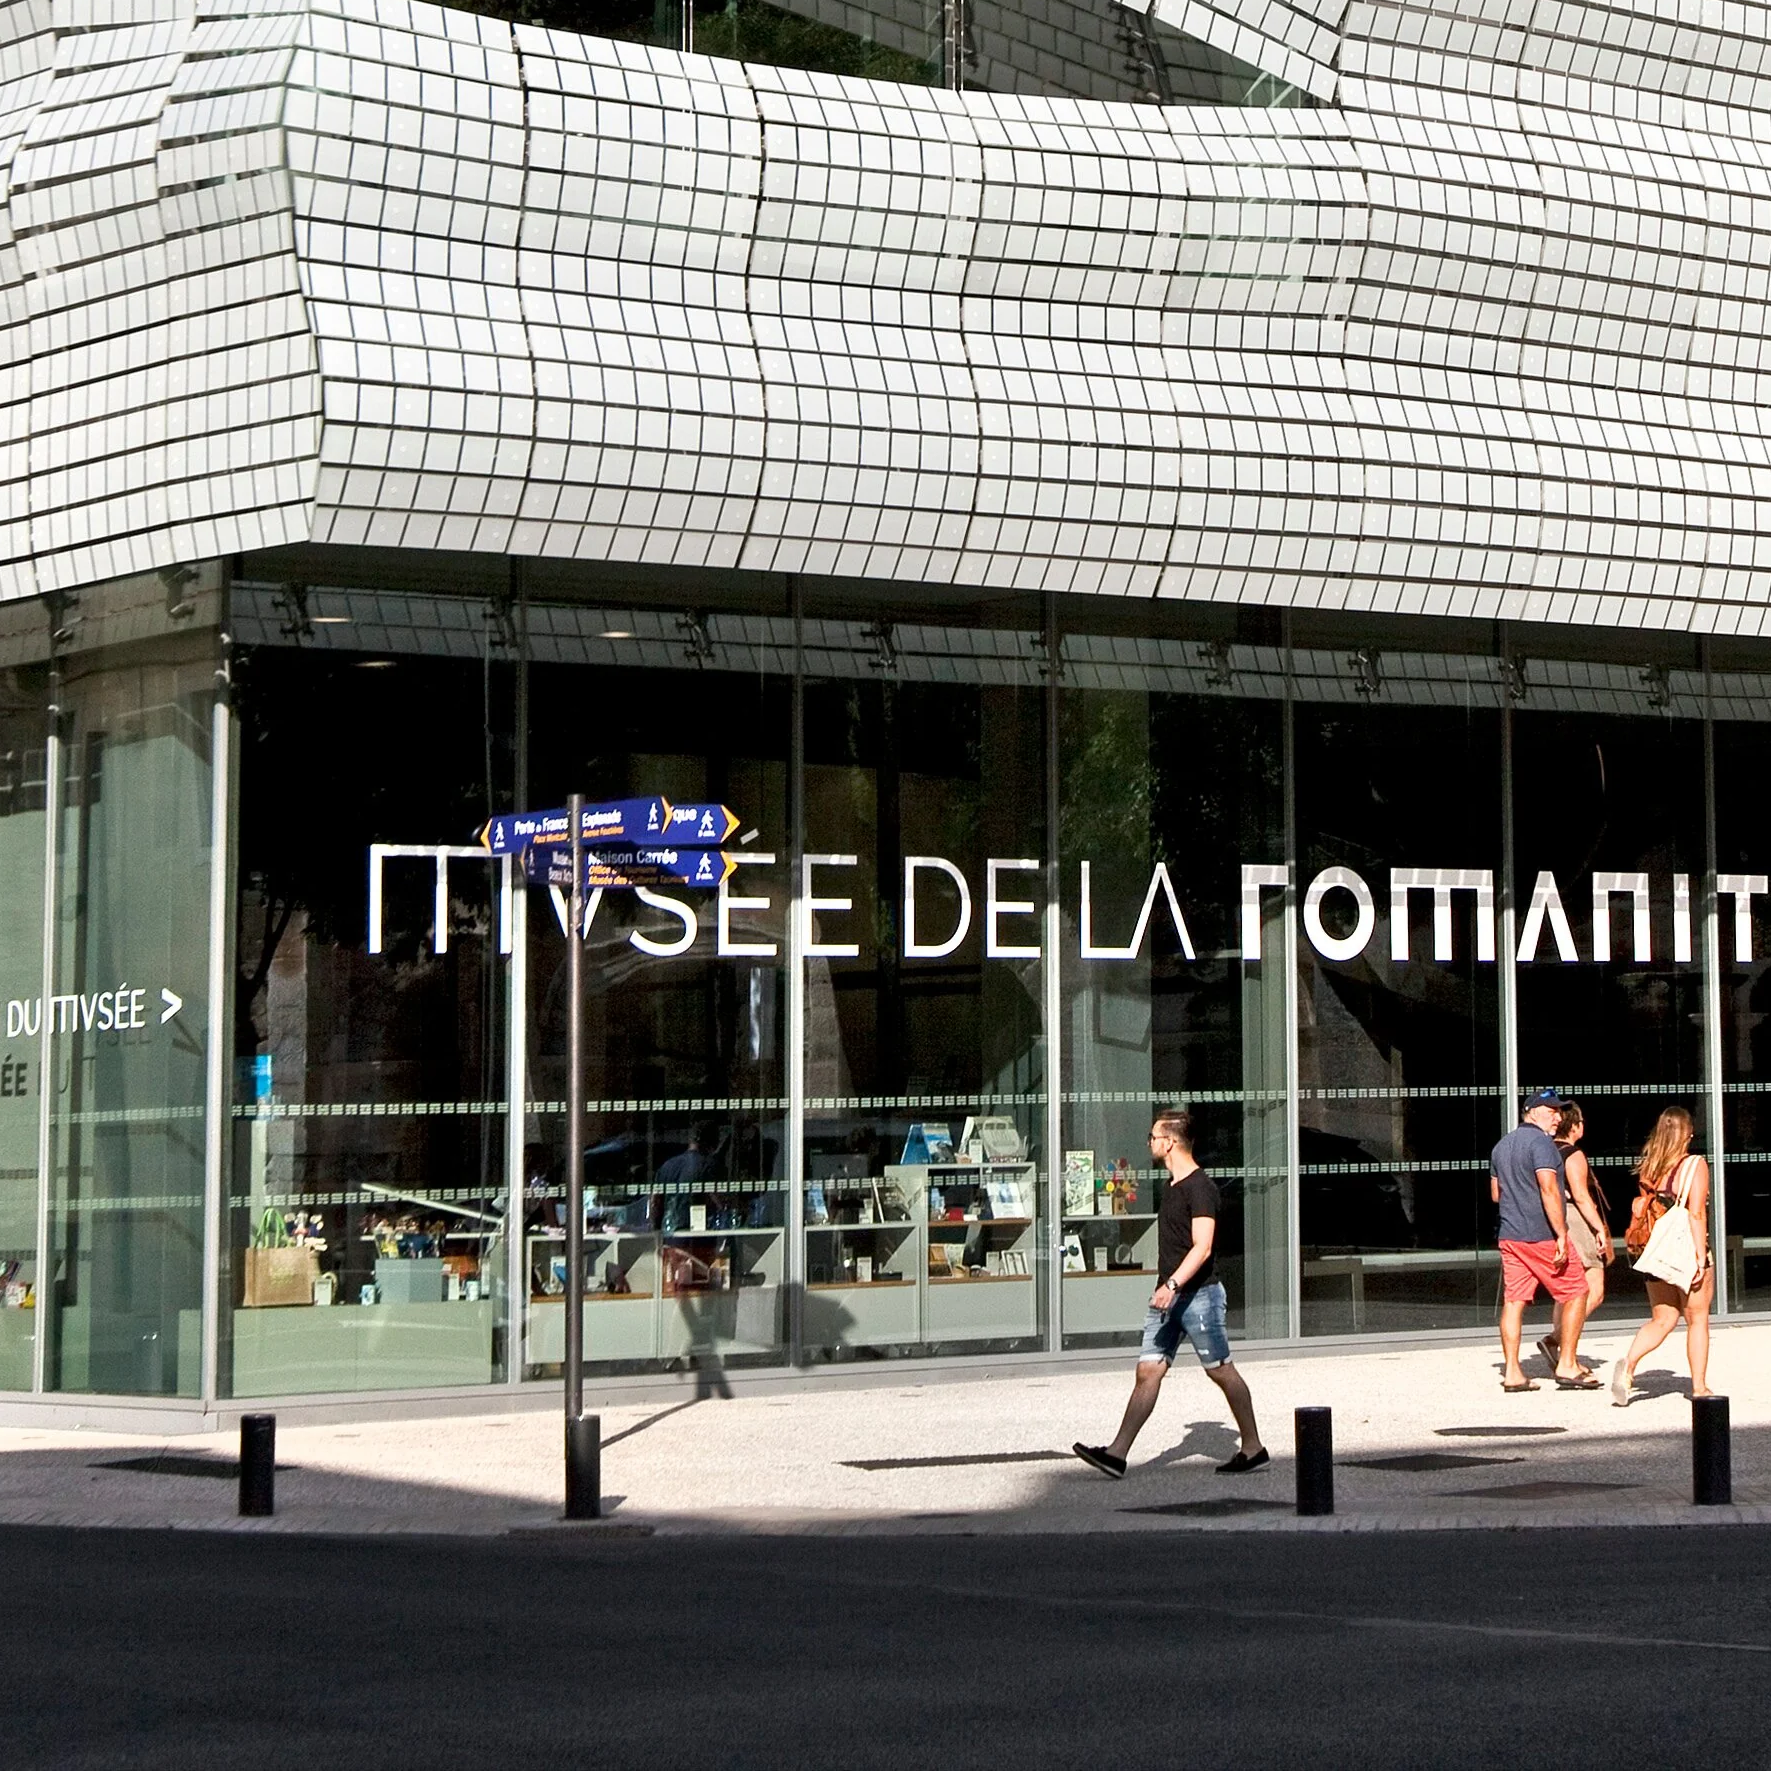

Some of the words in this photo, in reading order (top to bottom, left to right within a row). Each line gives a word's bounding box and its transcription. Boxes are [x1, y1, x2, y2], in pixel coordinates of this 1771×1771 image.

[588, 851, 633, 865] Maison
[636, 848, 678, 865] Carrée
[903, 855, 1043, 959] DE
[1080, 859, 1196, 960] LA
[6, 997, 41, 1038] DU
